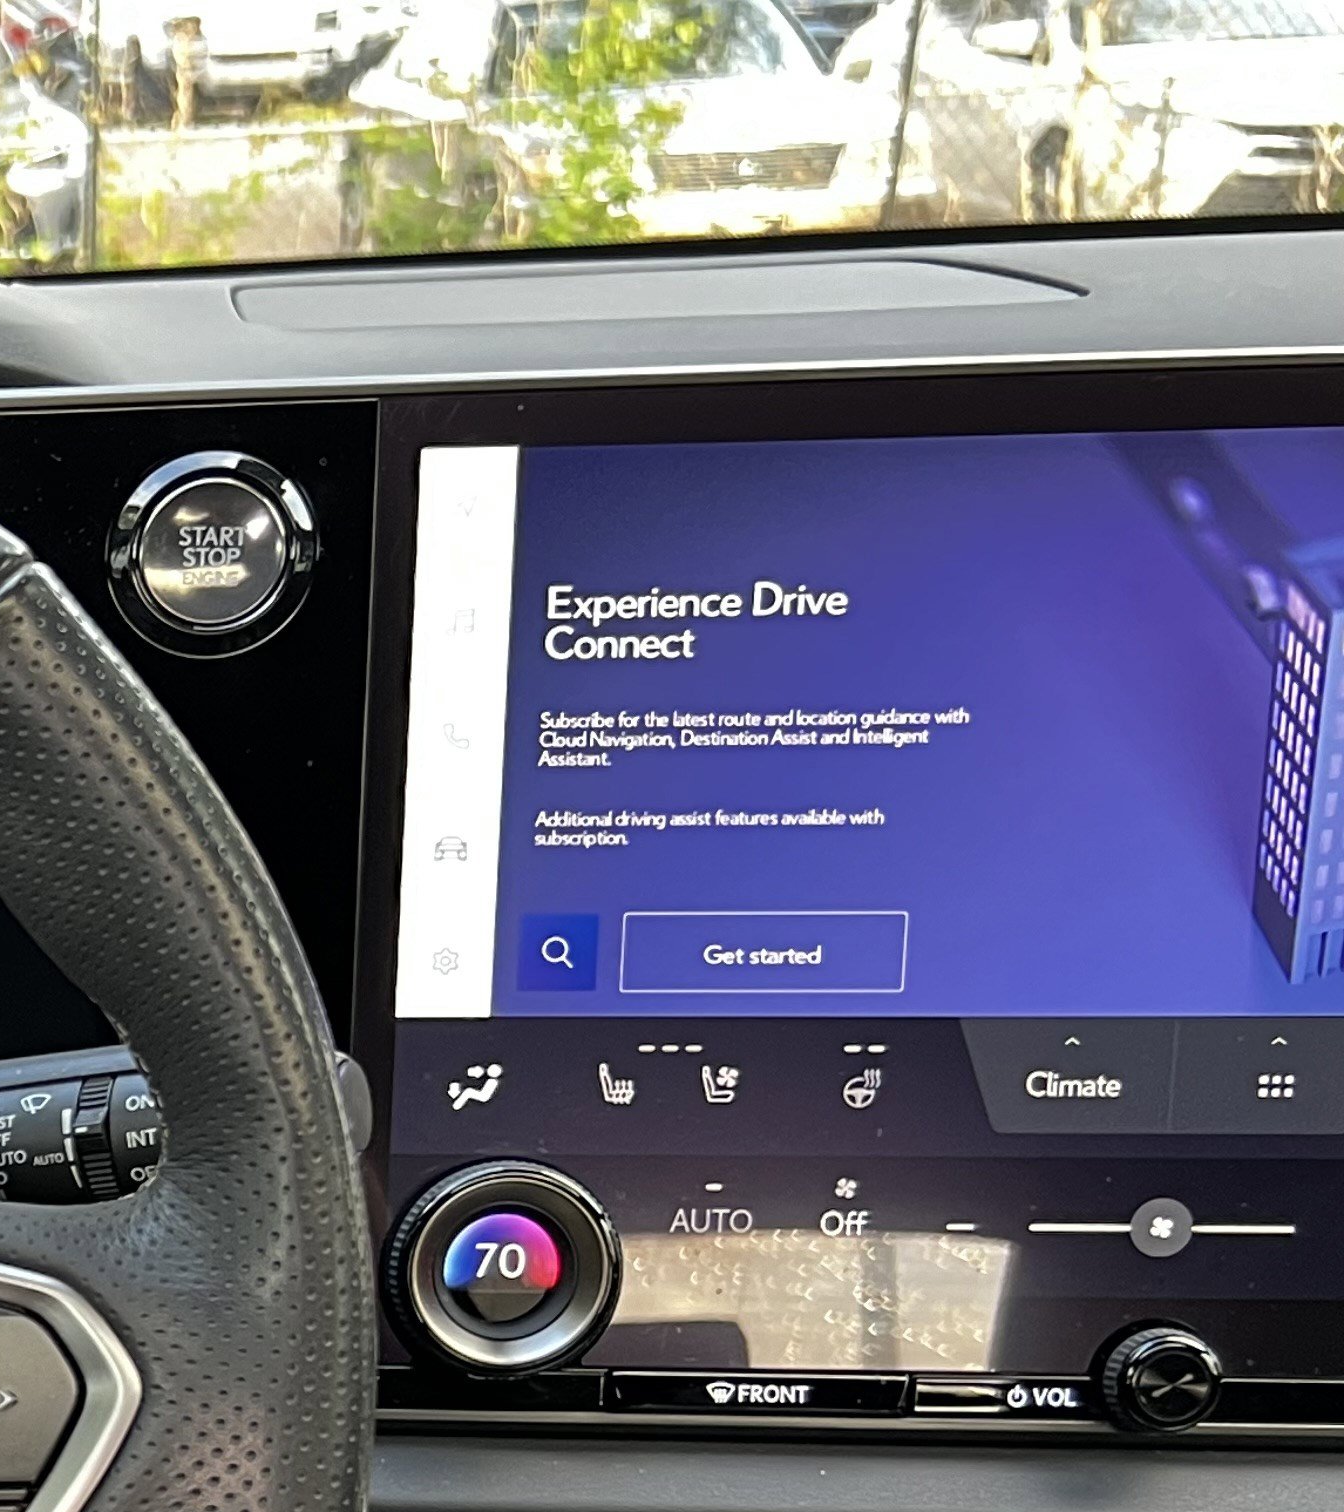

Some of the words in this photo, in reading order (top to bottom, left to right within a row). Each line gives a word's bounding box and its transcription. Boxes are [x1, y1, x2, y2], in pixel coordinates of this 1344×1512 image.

[178, 526, 246, 547] START
[182, 547, 241, 568] STOP
[182, 571, 240, 586] ENGINE
[547, 585, 742, 627] Experience
[752, 581, 849, 617] Drive
[544, 625, 695, 660] Connect
[540, 711, 614, 729] Subscribe
[618, 711, 640, 728] for
[644, 711, 669, 728] the
[673, 711, 715, 727] latest
[718, 712, 761, 727] route
[764, 709, 794, 726] and
[796, 709, 857, 726] location
[860, 708, 930, 729] guidance
[935, 707, 970, 725] with
[539, 730, 587, 748] Cloud
[589, 730, 677, 751] Navigation,
[680, 729, 768, 747] Destination
[770, 729, 818, 746] Assist
[820, 728, 850, 745] and
[853, 728, 929, 748] Intelligent
[537, 750, 611, 767] Assistant.
[534, 810, 612, 828] Additional
[615, 810, 666, 830] driving
[669, 811, 711, 826] assist
[715, 809, 778, 826] features
[781, 809, 847, 826] available
[849, 808, 885, 825] with
[534, 830, 630, 849] subscription.
[703, 944, 745, 965] Get
[749, 945, 822, 965] started
[1025, 1070, 1123, 1098] Climate
[126, 1127, 158, 1148] INT
[33, 1152, 65, 1167] AUTO
[669, 1208, 753, 1234] AUTO
[820, 1209, 869, 1236] Off
[474, 1241, 527, 1281] 70
[738, 1383, 810, 1405] FRONT
[1032, 1386, 1077, 1408] VOL
